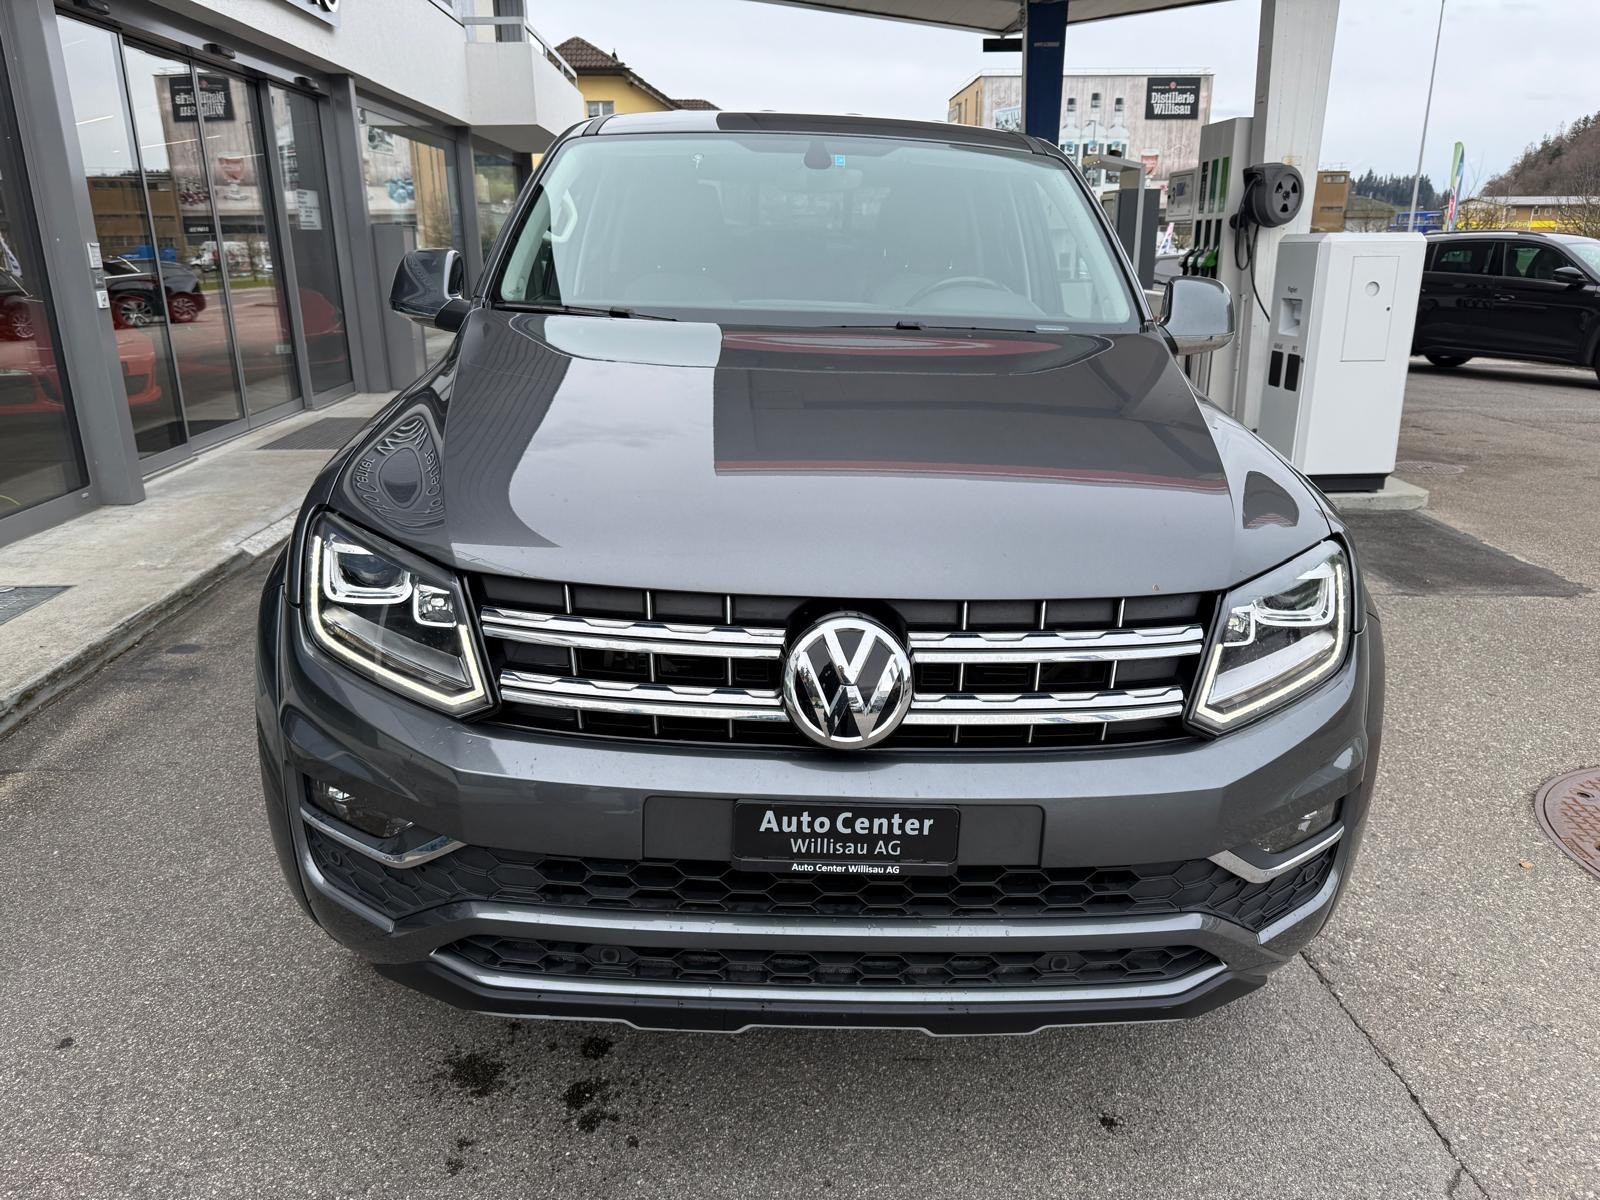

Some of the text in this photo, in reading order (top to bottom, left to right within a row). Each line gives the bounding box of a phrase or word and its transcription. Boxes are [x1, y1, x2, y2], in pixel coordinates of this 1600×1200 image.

[1151, 91, 1195, 104] Distillerie
[1153, 103, 1191, 115] Willisau
[759, 810, 934, 836] Auto Center
[790, 838, 901, 856] Willisau AG
[791, 863, 901, 874] Auto Center Willisau AG
